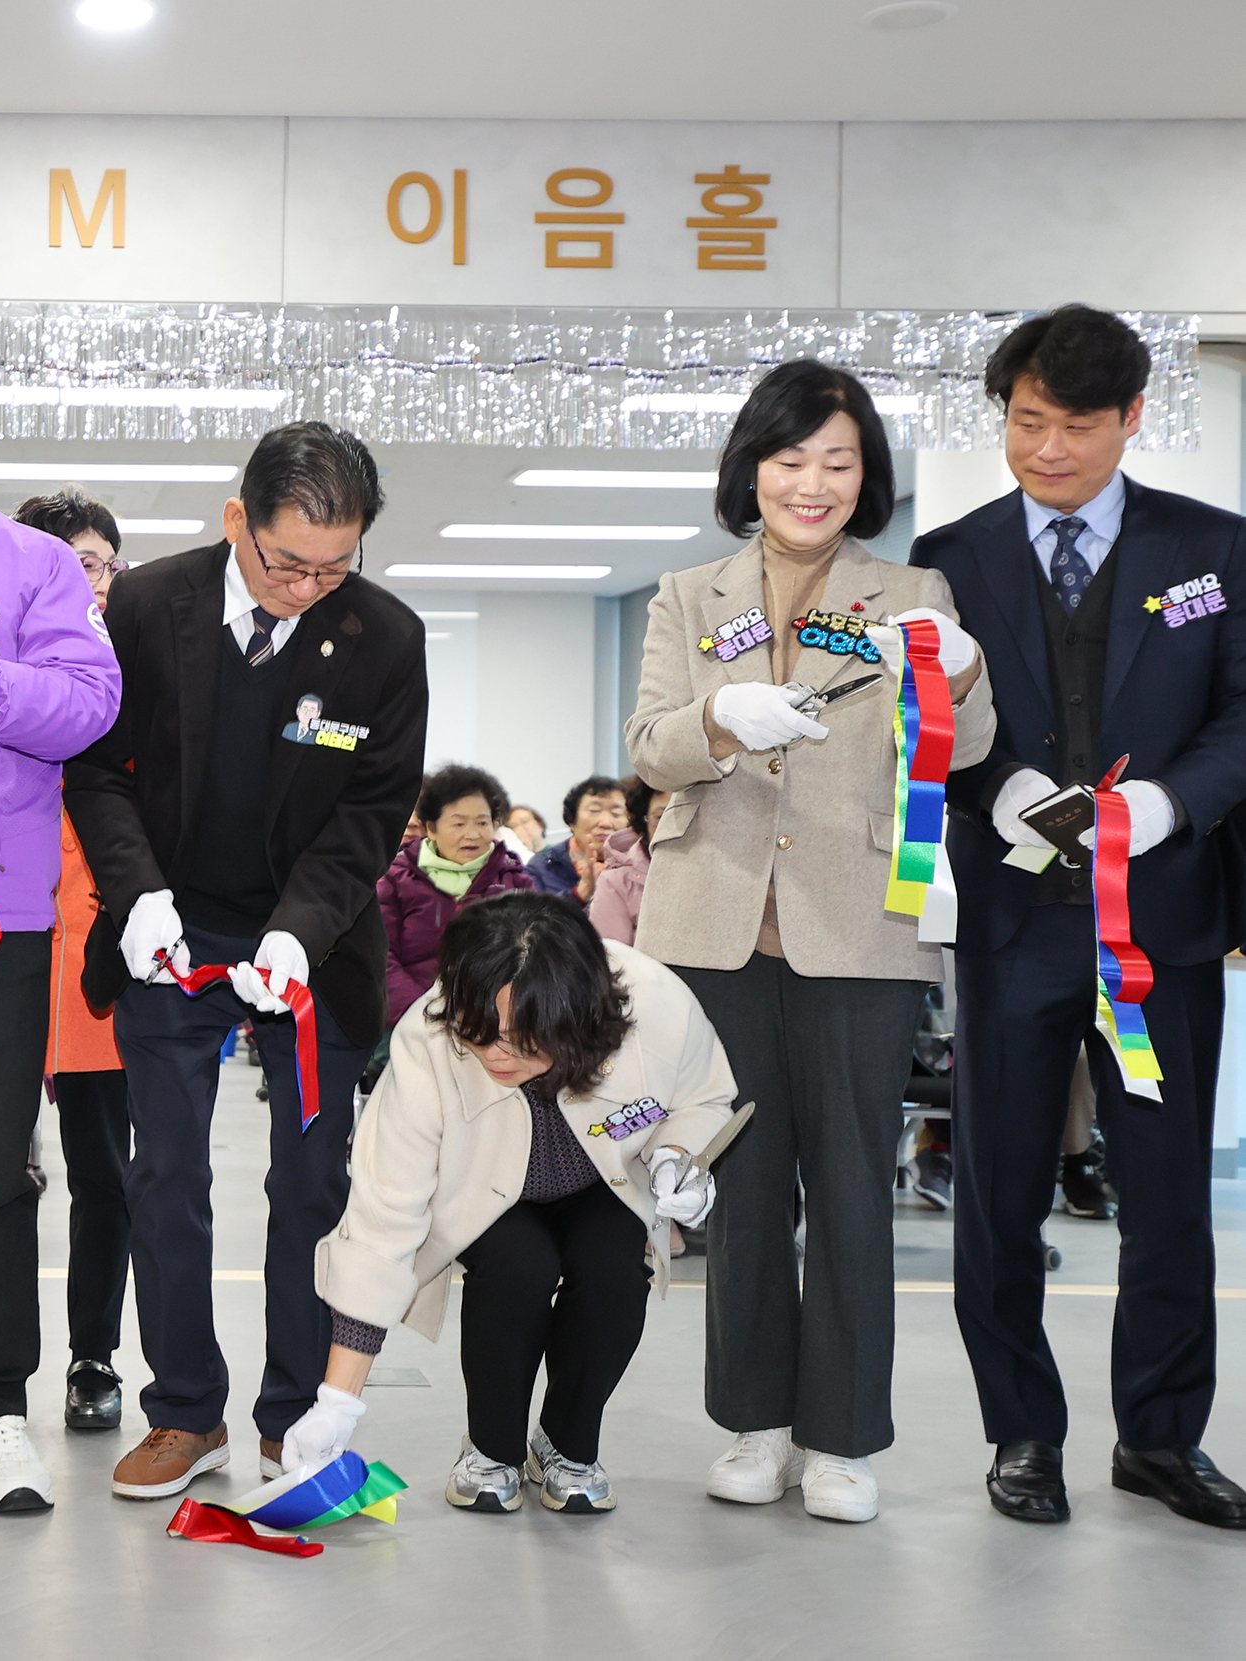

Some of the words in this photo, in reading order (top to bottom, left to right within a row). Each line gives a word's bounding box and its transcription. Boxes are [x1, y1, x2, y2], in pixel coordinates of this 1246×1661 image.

[386, 164, 778, 271] 이음홀
[1166, 572, 1222, 605] 좋아요
[717, 606, 766, 641] 좋아요
[807, 609, 881, 636] 사무국
[1162, 589, 1227, 629] 동대문
[715, 620, 774, 662] 동대문
[315, 730, 358, 752] 이태인
[607, 1097, 658, 1126] 좋아요
[607, 1105, 669, 1141] 동대문
